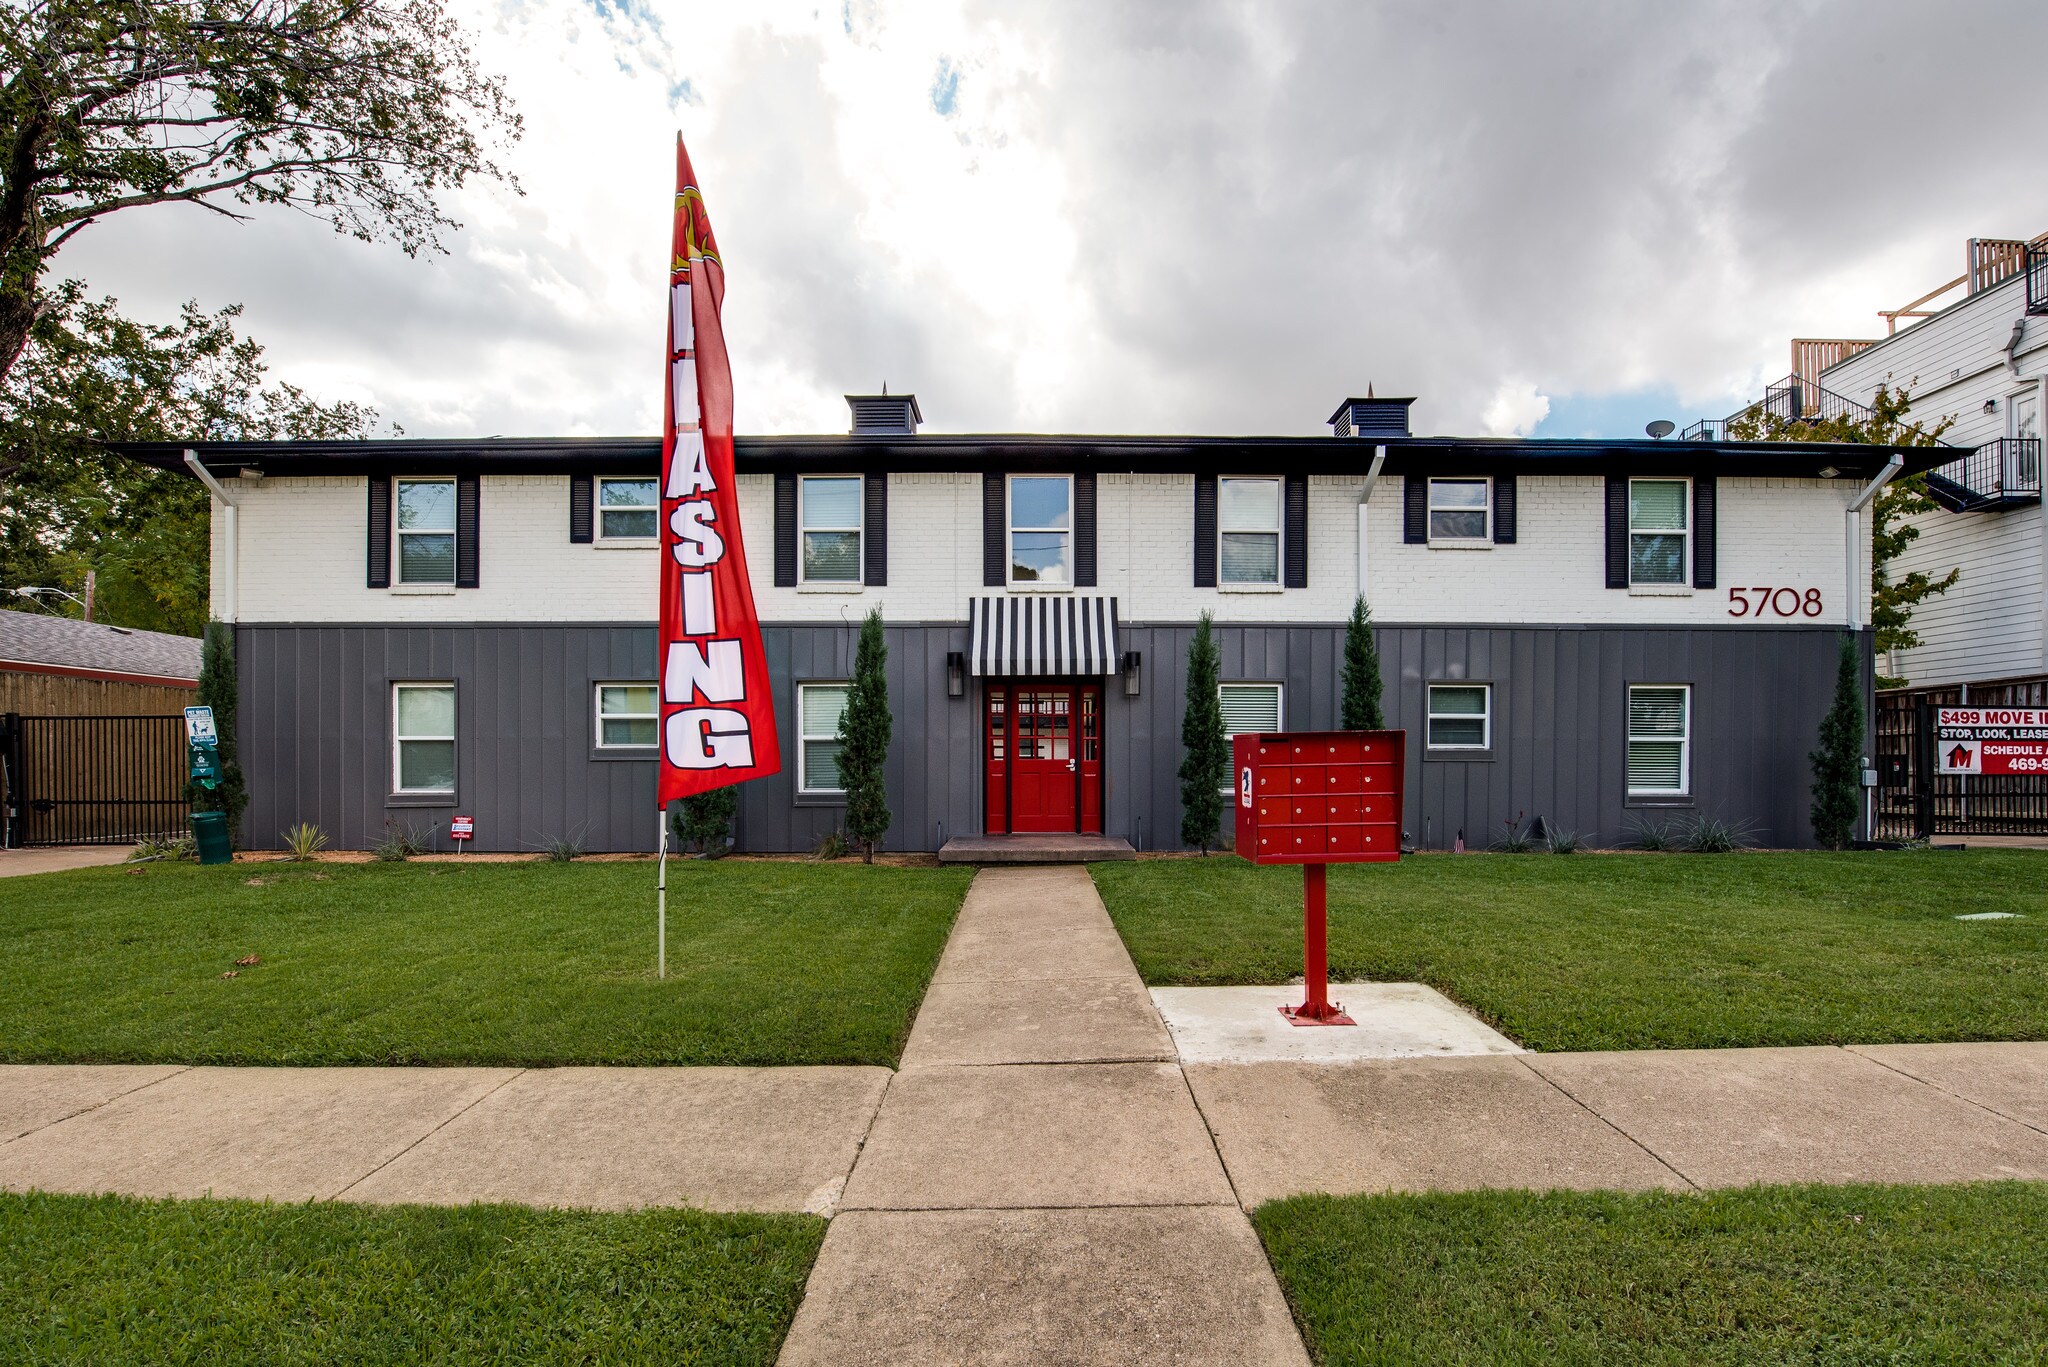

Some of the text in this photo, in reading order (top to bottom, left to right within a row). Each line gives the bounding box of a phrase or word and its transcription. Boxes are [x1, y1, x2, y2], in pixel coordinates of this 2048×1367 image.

[1728, 587, 1823, 617] 5708
[1940, 710, 1981, 725] $499
[1985, 711, 2035, 725] MOVE
[1940, 729, 2048, 740] STOP, LOOK, LEASE
[1983, 745, 2043, 755] SCHEDULE
